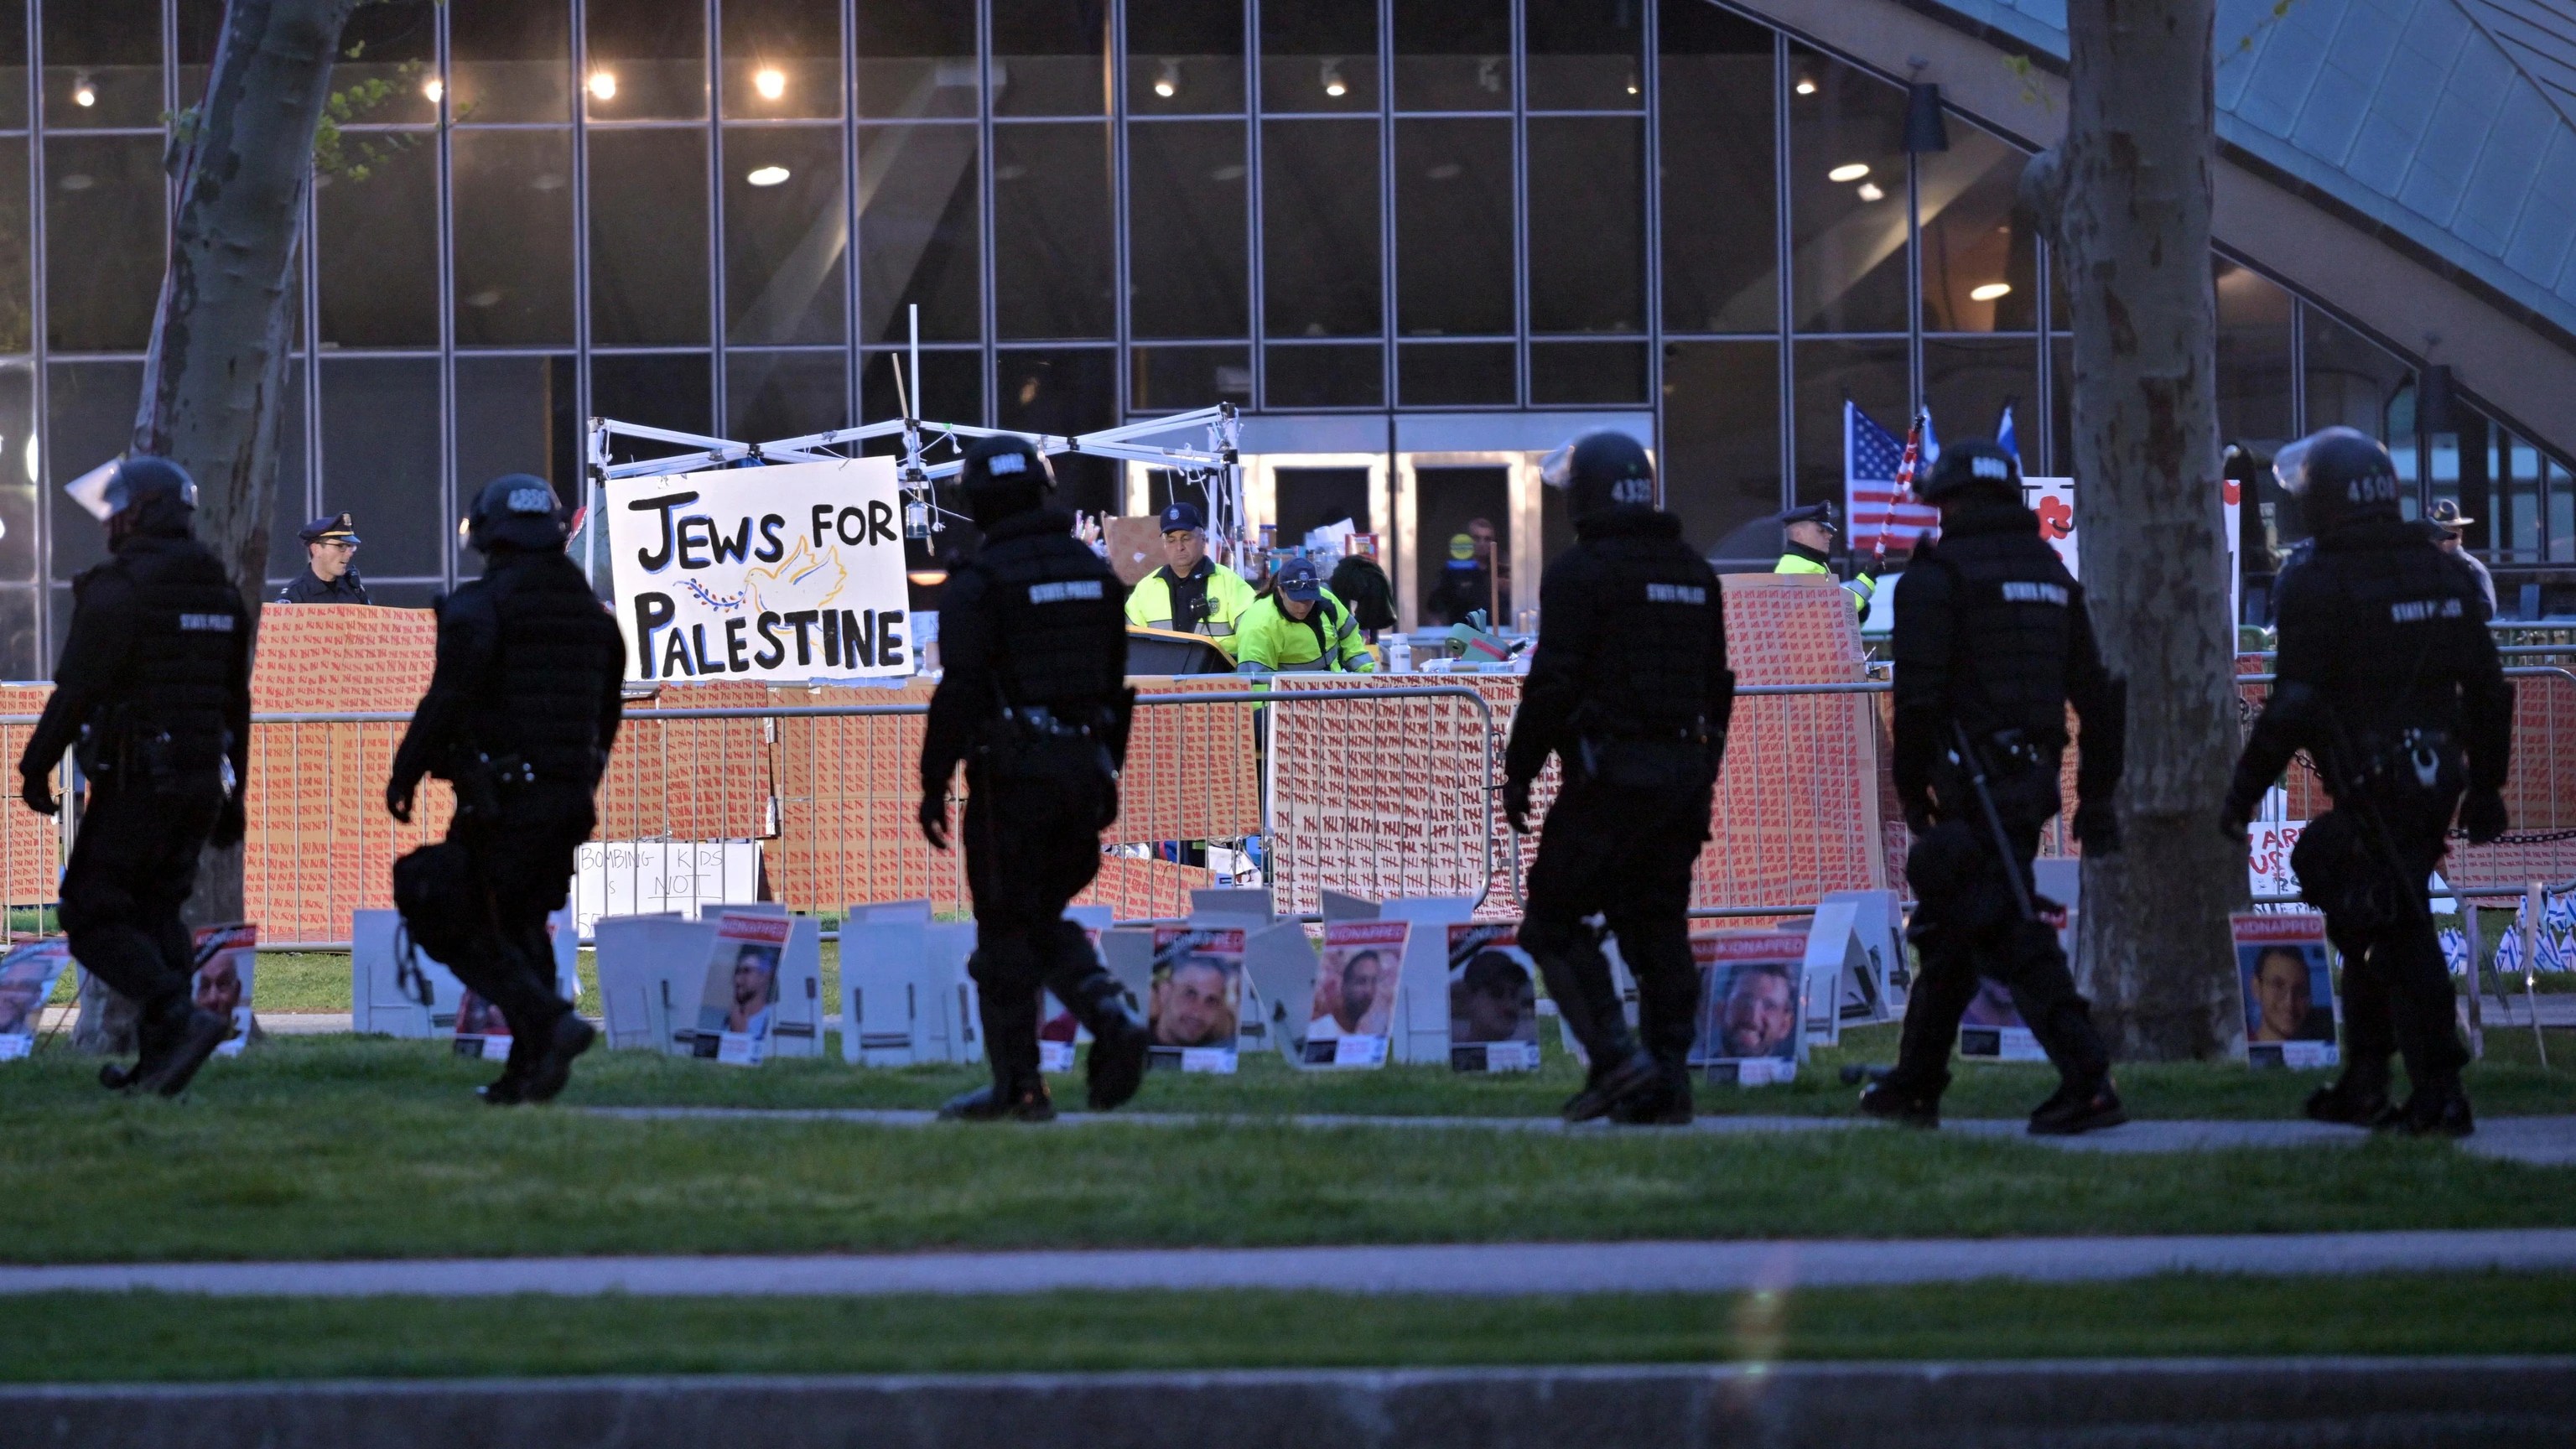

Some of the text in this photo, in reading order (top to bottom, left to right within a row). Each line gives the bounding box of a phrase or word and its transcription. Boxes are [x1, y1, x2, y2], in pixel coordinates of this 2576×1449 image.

[628, 491, 897, 574] JEWS FOR
[635, 592, 905, 679] PALESTINE
[581, 847, 723, 870] BOMBING KDS
[654, 874, 711, 896] NOT
